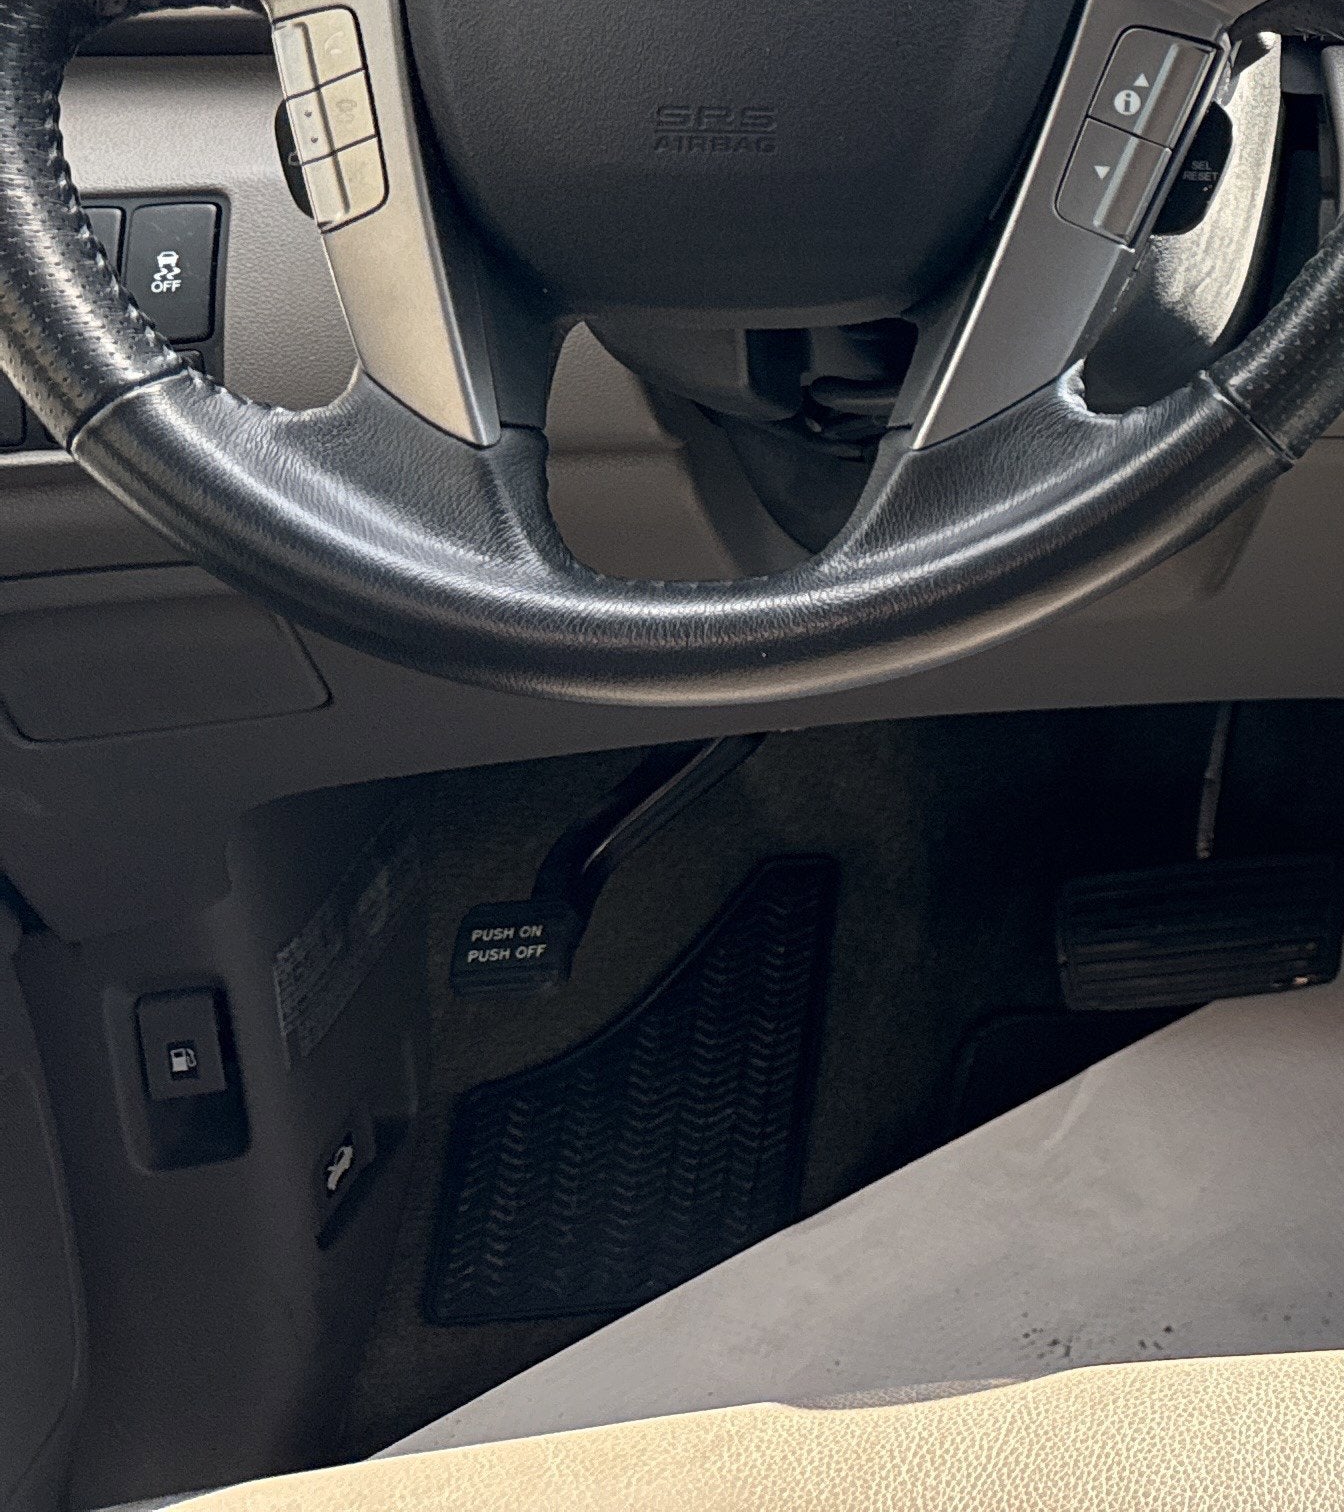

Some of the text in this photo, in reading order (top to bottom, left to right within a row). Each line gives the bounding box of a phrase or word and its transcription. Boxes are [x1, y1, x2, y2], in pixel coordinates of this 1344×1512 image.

[654, 137, 777, 154] AIRBAG
[151, 280, 181, 293] OFF
[471, 924, 544, 943] PUSH ON
[467, 943, 547, 963] PUSH OFF
